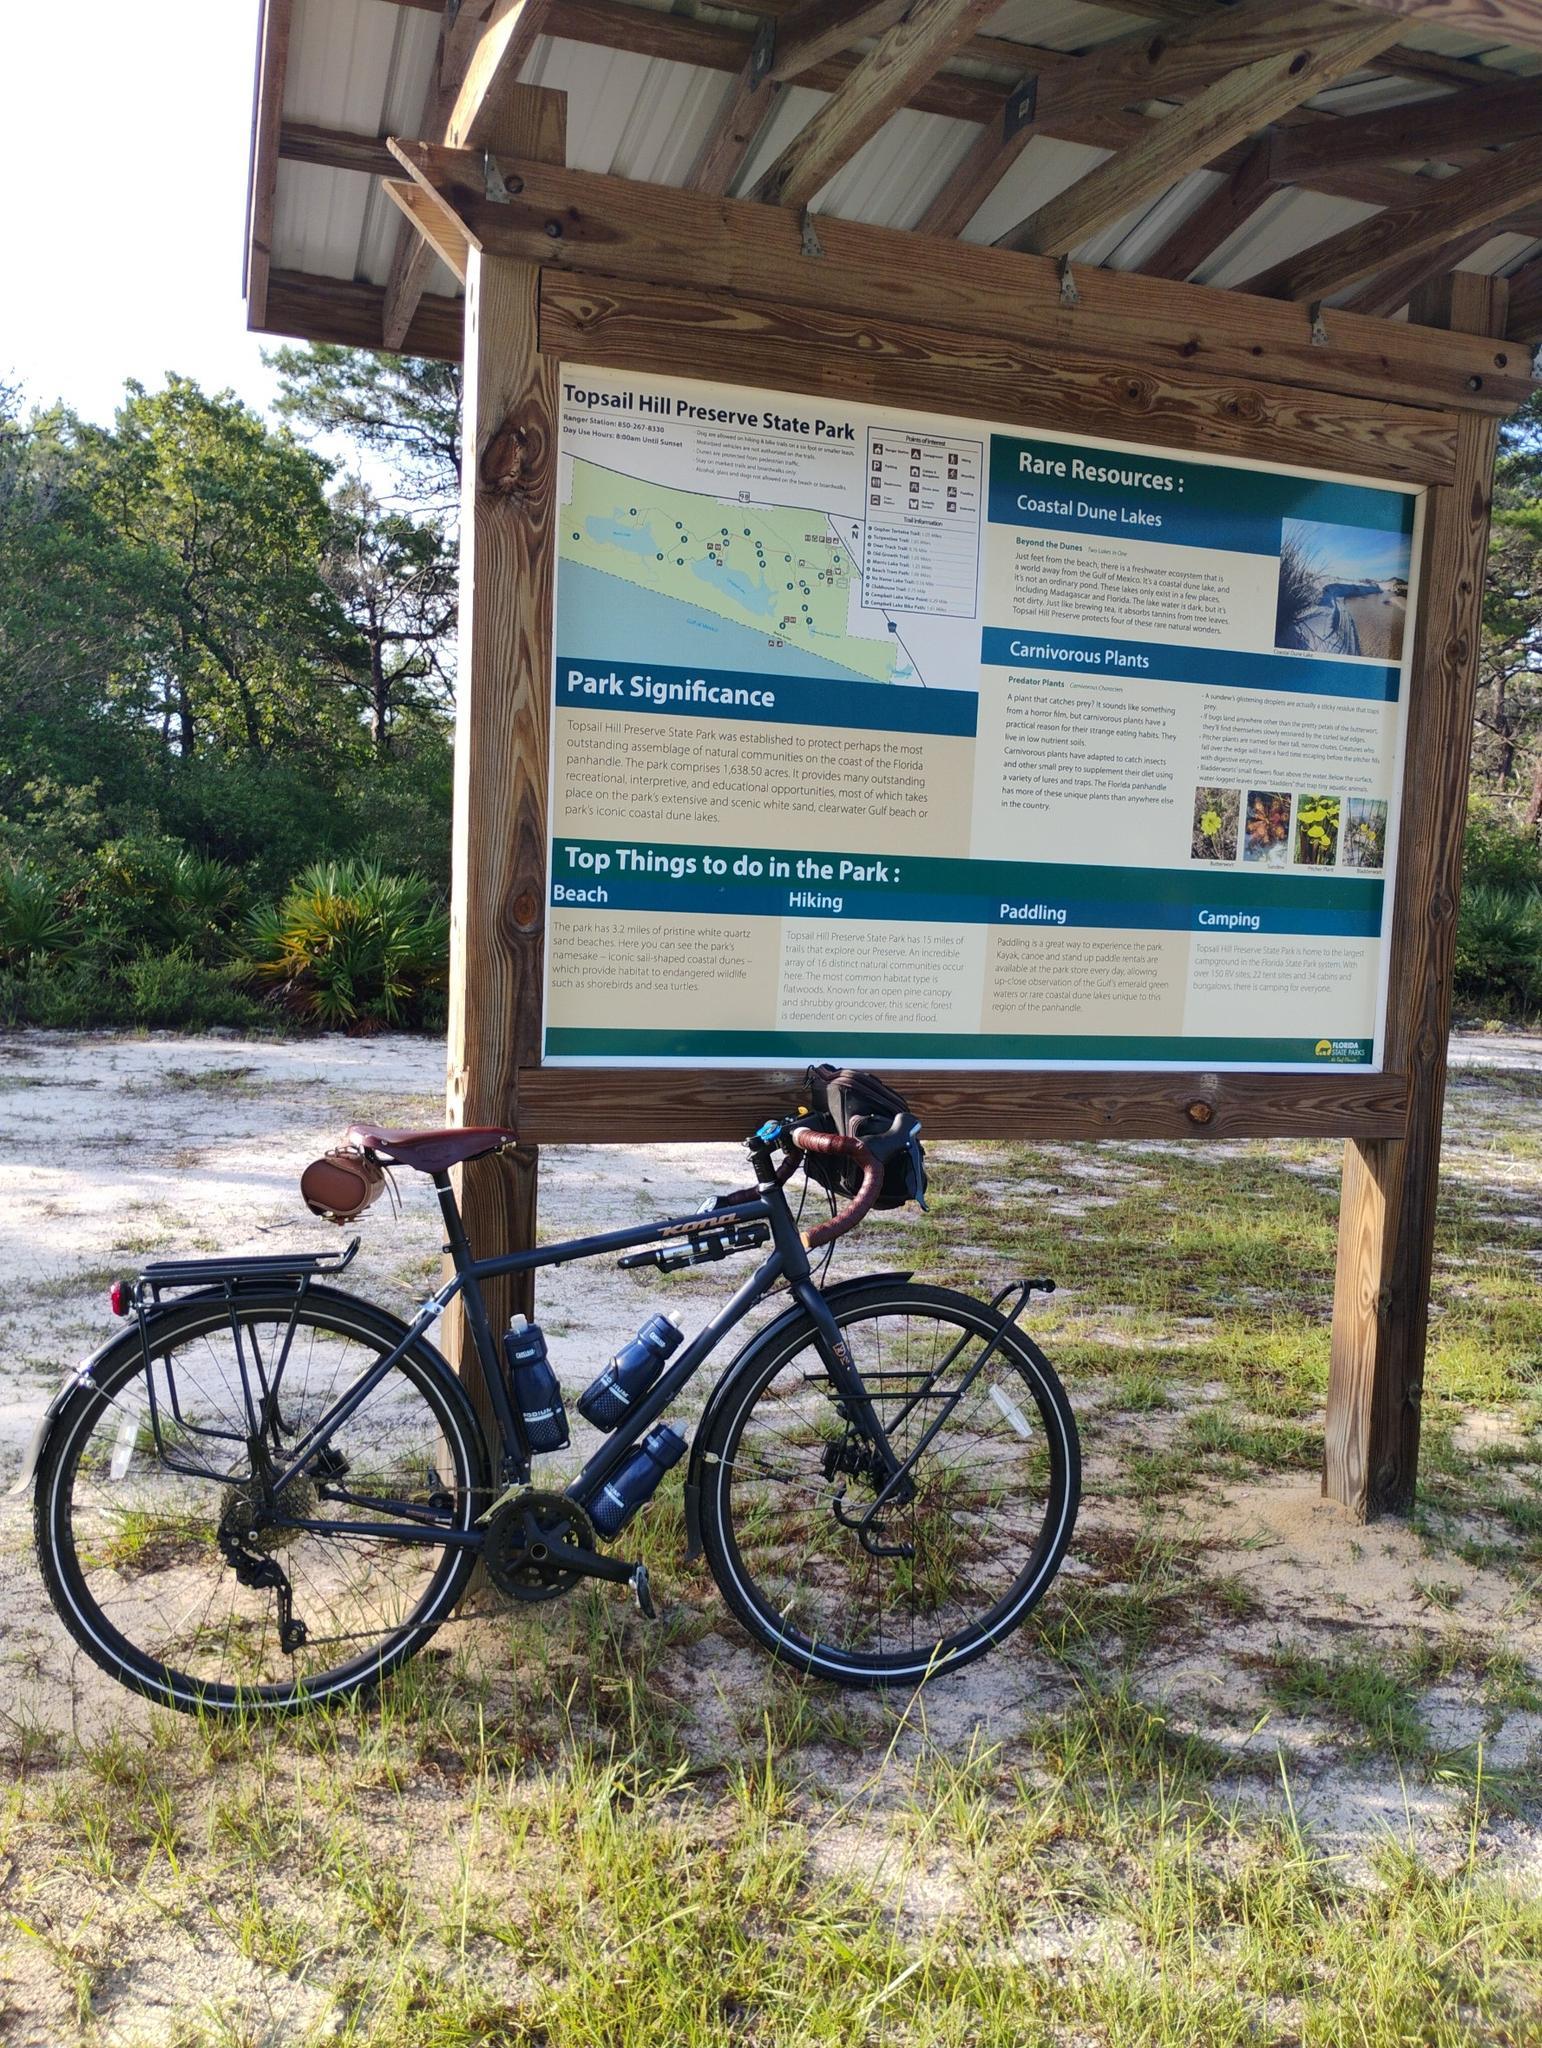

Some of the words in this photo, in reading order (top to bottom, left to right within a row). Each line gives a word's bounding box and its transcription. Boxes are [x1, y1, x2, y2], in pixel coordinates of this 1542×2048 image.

[562, 383, 633, 414] Topsail
[639, 394, 670, 415] Hill
[676, 399, 758, 427] Preserve
[762, 412, 810, 434] State
[814, 419, 854, 440] Park
[563, 413, 588, 425] Ranger
[589, 417, 616, 427] Station:
[617, 420, 664, 433] 850-267-8330
[562, 426, 576, 435] Day
[592, 429, 614, 438] Hours:
[616, 433, 641, 442] 8:00am
[642, 436, 658, 444] Until
[660, 438, 682, 447] Sunset
[1019, 451, 1066, 477] Rare
[1071, 459, 1173, 491] Resources
[1178, 478, 1183, 492] :
[1017, 494, 1073, 515] Coastal
[1077, 502, 1117, 521] Dune
[1120, 507, 1162, 526] Lakes
[1015, 536, 1044, 549] Beyond
[1045, 540, 1058, 549] the
[1059, 541, 1082, 551] Dunes
[1011, 605, 1037, 617] Topsail
[1038, 608, 1050, 617] Hill
[1050, 609, 1080, 620] Preserve
[1081, 612, 1110, 625] protects
[1110, 615, 1124, 624] four
[1134, 618, 1152, 627] these
[1168, 621, 1191, 631] natural
[1192, 624, 1221, 634] wonders.
[1009, 640, 1101, 663] Carnivorous
[1104, 649, 1149, 668] Plants
[568, 669, 624, 695] Park
[630, 674, 775, 710] Significance
[1008, 675, 1040, 685] Predator
[1042, 678, 1064, 687] Plants
[1013, 693, 1032, 704] plant
[1033, 695, 1047, 703] that
[1048, 696, 1075, 706] catches
[1076, 699, 1094, 709] prey?
[1102, 701, 1126, 710] sounds
[1127, 703, 1140, 711] like
[1139, 704, 1175, 716] something
[1006, 704, 1023, 714] from
[1030, 707, 1052, 717] horror
[1053, 709, 1069, 720] film,
[1069, 711, 1081, 720] but
[1082, 712, 1122, 724] carnivorous
[1122, 716, 1143, 728] plants
[1144, 718, 1160, 728] have
[565, 718, 604, 735] Topsail
[605, 721, 621, 733] Hill
[622, 723, 666, 736] Preserve
[666, 726, 695, 738] State
[694, 728, 716, 740] Park
[717, 732, 737, 741] was
[739, 731, 793, 745] established
[795, 735, 806, 746] to
[807, 736, 843, 752] protect
[843, 739, 881, 755] perhaps
[883, 742, 898, 753] the
[899, 743, 923, 755] most
[564, 753, 623, 770] panhandle.
[624, 757, 645, 769] The
[646, 758, 669, 773] park
[668, 760, 720, 776] comprises
[721, 763, 763, 778] 1,638.50
[763, 768, 791, 778] acres.
[791, 768, 800, 779] It
[801, 768, 841, 784] provides
[843, 774, 870, 786] many
[869, 773, 925, 789] outstanding
[564, 846, 610, 875] Top
[615, 848, 696, 879] Things
[702, 853, 727, 875] to
[732, 854, 763, 876] do
[769, 856, 790, 877] in
[795, 857, 833, 879] the
[839, 859, 889, 882] Park
[894, 867, 899, 882] :
[553, 884, 607, 902] Beach
[789, 891, 842, 912] Hiking
[1000, 903, 1066, 924] Paddling
[1198, 910, 1260, 929] Camping
[552, 922, 571, 934] The
[571, 922, 594, 938] park
[594, 923, 609, 935] has
[610, 923, 624, 936] 3.2
[627, 924, 651, 936] miles
[662, 925, 695, 941] pristine
[697, 926, 721, 939] white
[722, 927, 753, 943] quartz
[785, 930, 814, 943] Topsail
[816, 931, 829, 941] Hill
[831, 932, 866, 942] Preserve
[865, 933, 888, 943] State
[887, 934, 906, 943] Park
[907, 934, 920, 944] has
[933, 935, 954, 945] miles
[995, 937, 1031, 949] Paddling
[1044, 939, 1064, 950] great
[1065, 942, 1081, 951] way
[1091, 941, 1132, 952] experience
[1133, 942, 1145, 950] the
[1146, 943, 1163, 953] park.
